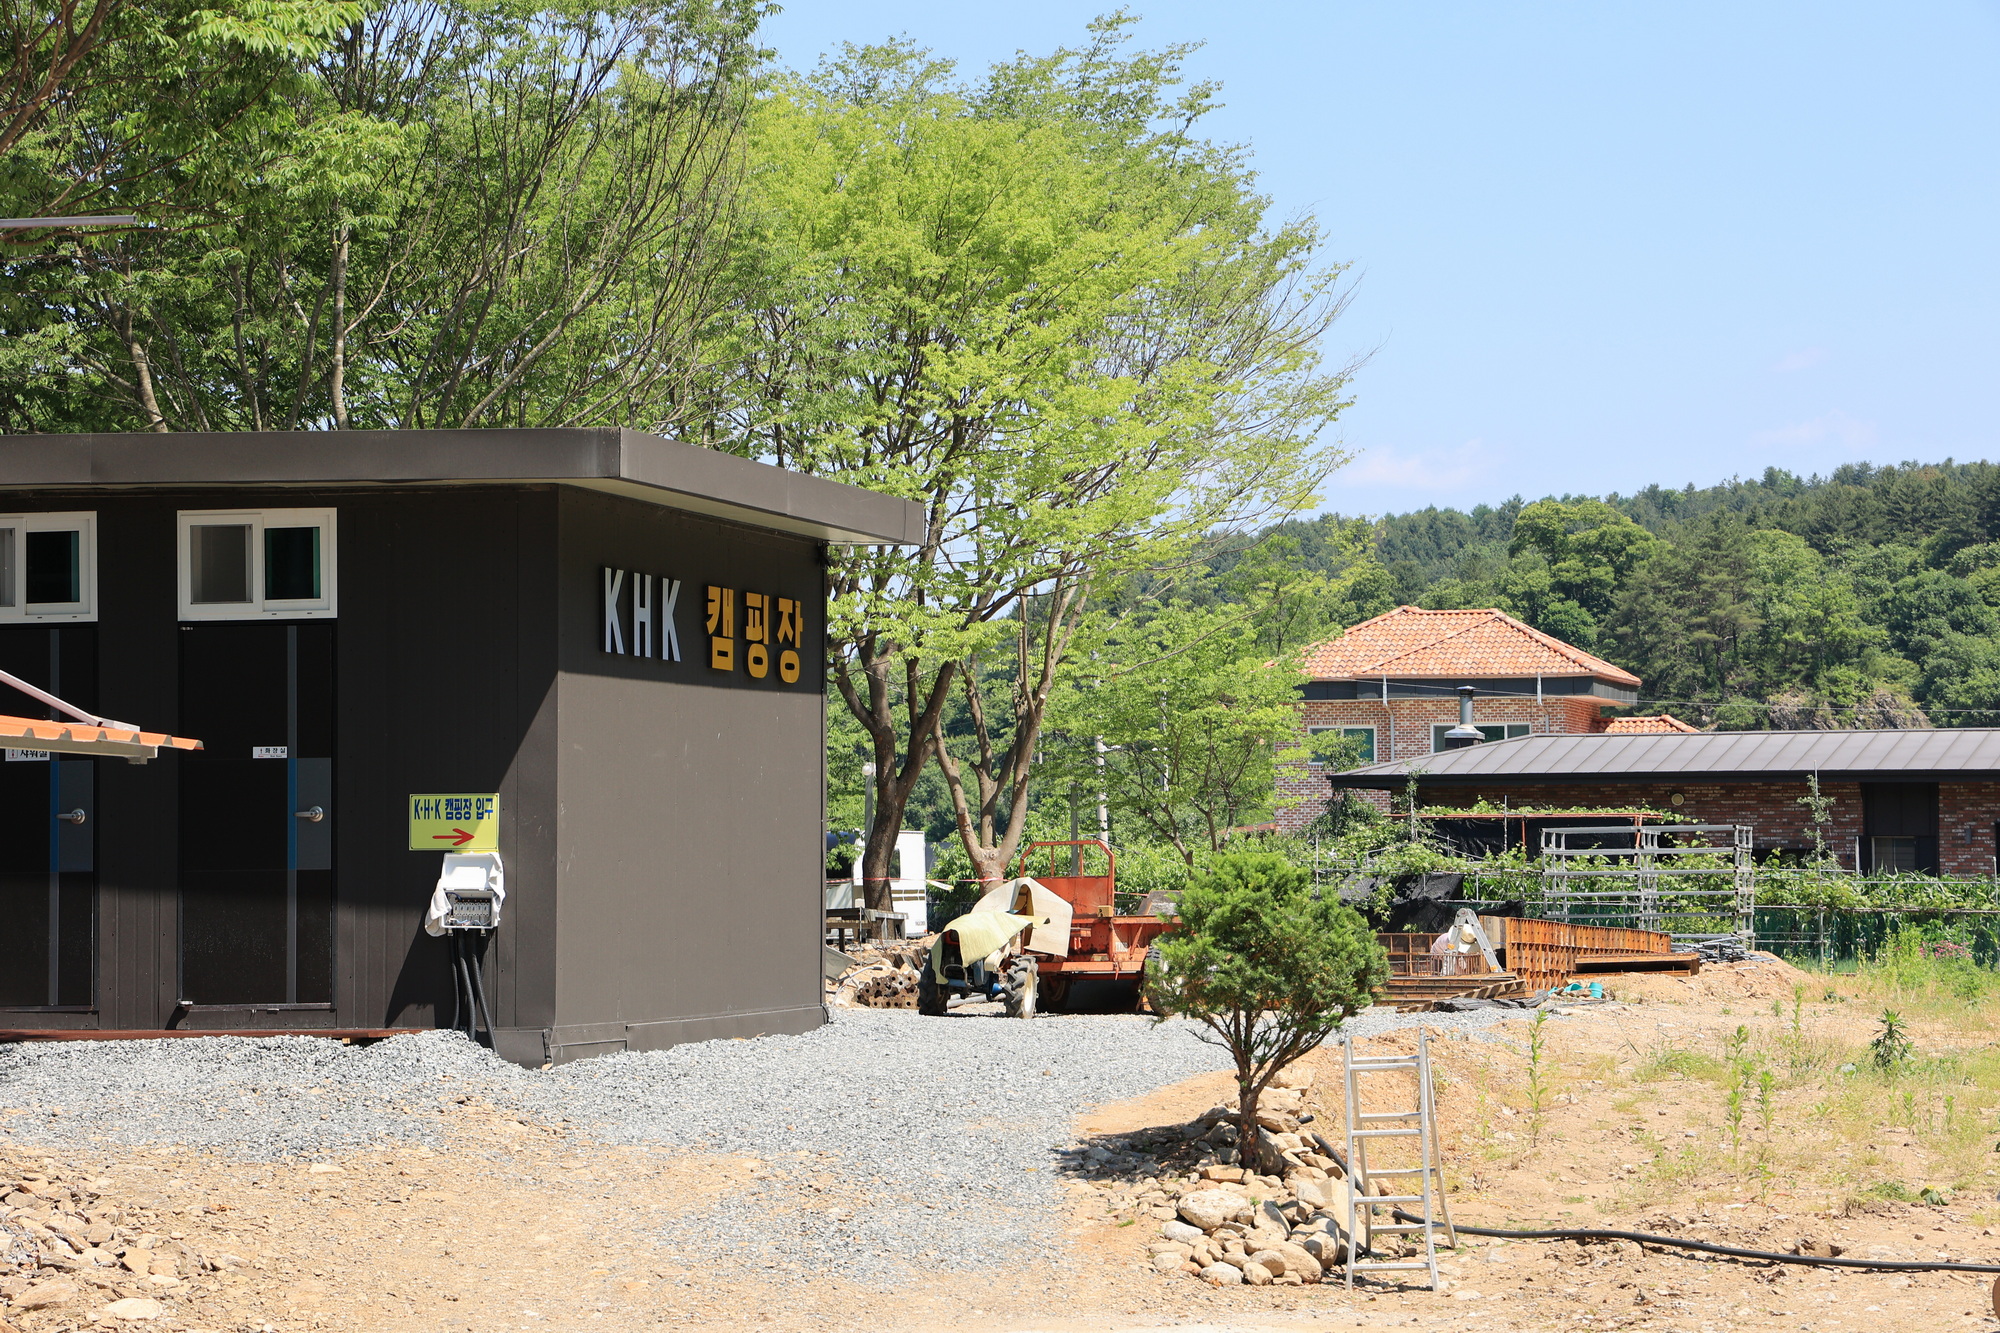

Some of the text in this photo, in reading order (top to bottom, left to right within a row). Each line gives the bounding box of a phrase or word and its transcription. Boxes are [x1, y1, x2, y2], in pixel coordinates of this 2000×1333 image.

[604, 567, 804, 684] KHK 캠핑장
[445, 798, 472, 820] 캠핑장
[476, 798, 494, 820] 입구
